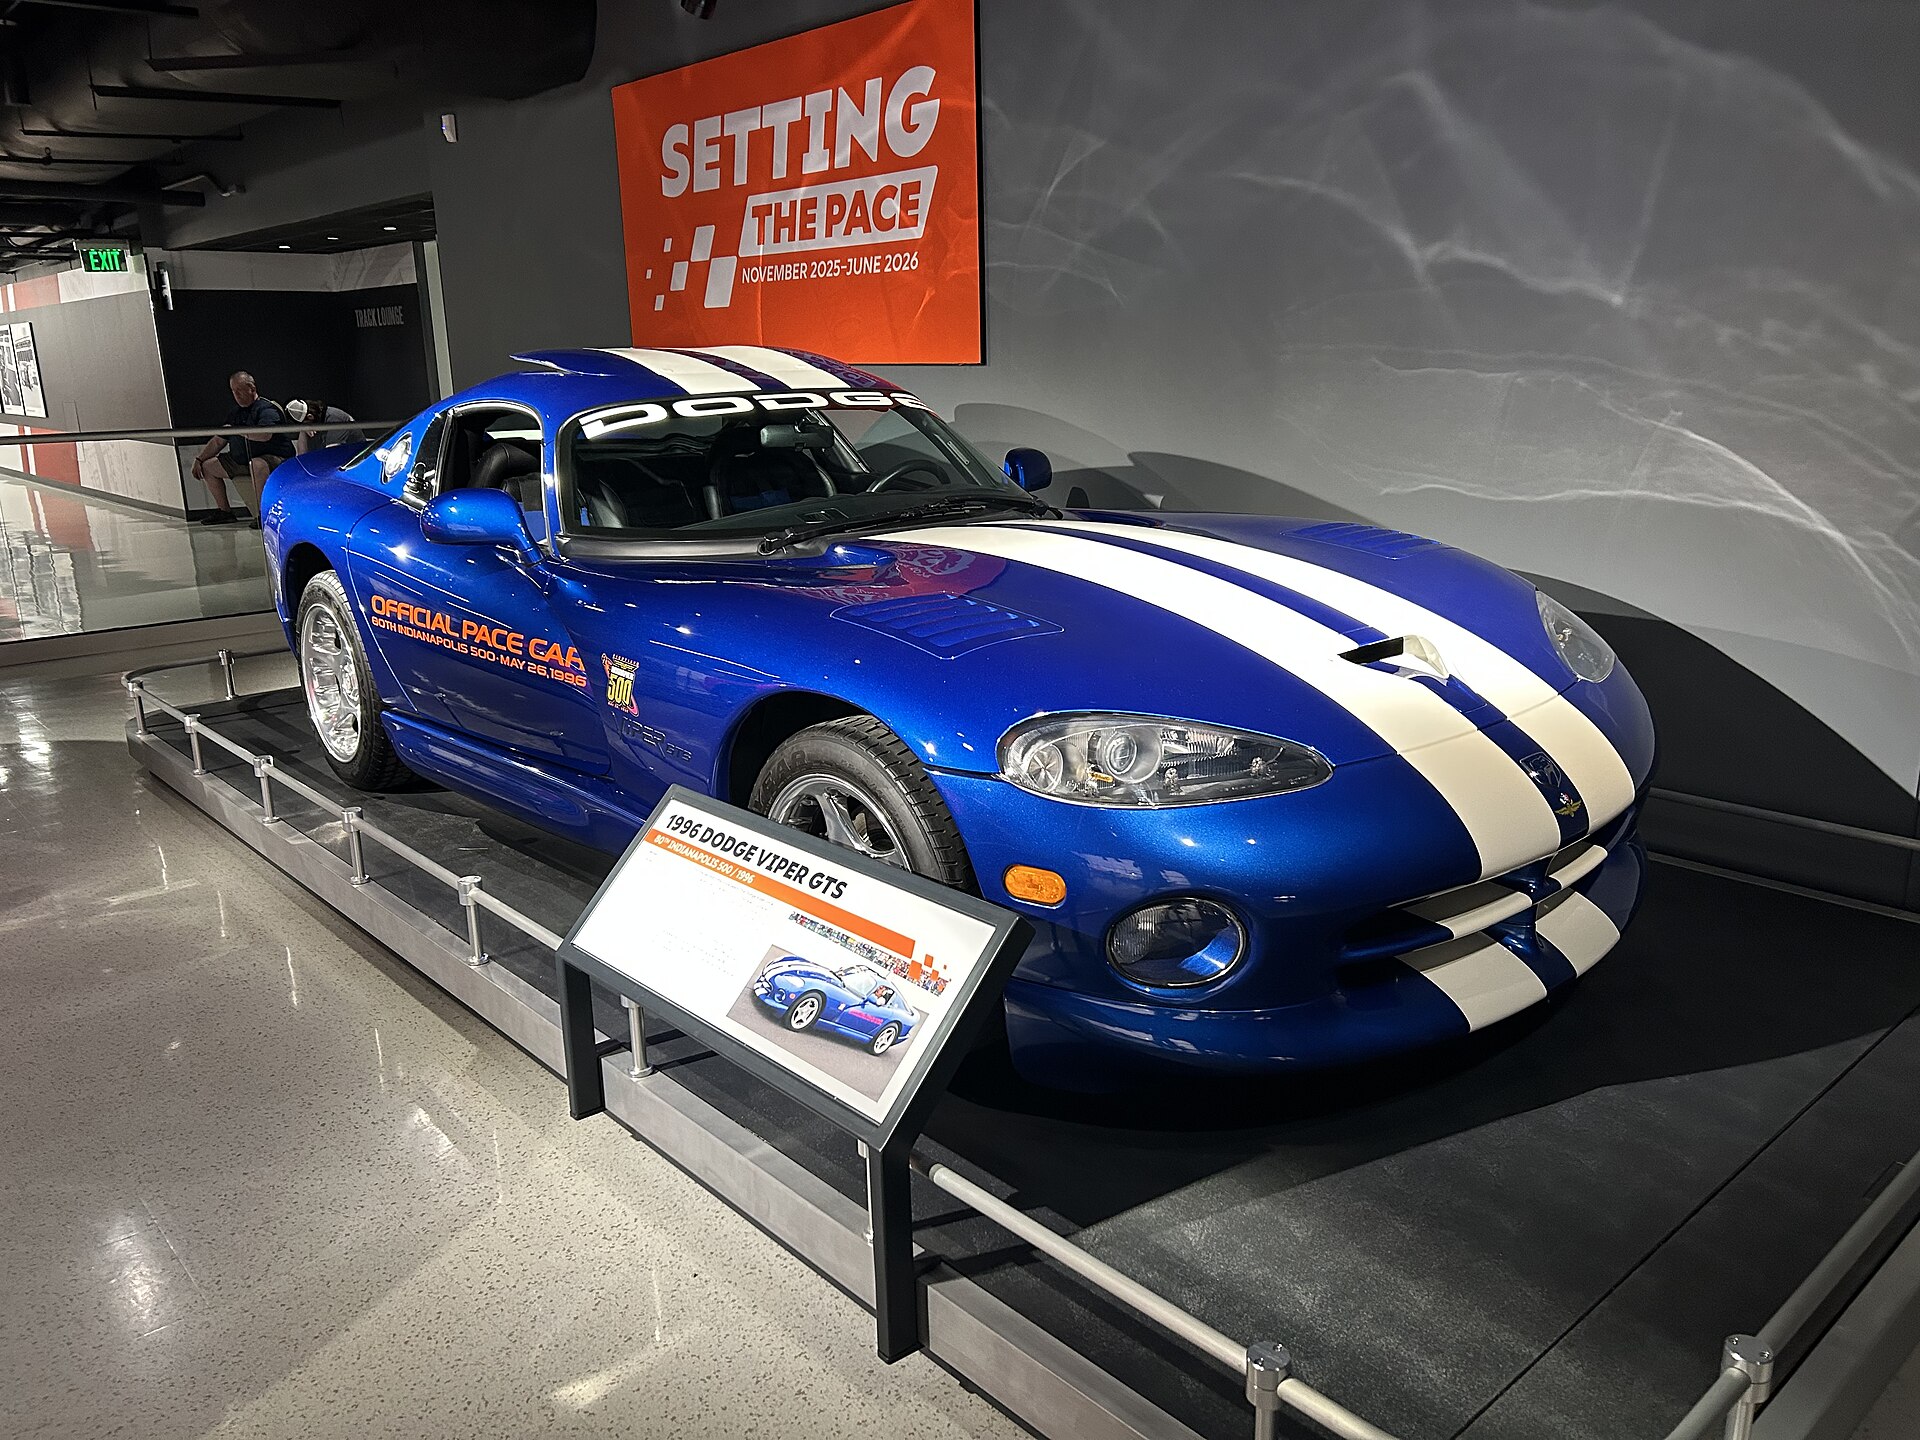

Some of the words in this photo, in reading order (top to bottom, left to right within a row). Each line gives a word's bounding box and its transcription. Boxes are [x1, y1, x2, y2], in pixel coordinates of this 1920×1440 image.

[661, 65, 941, 198] SETTING
[751, 199, 818, 246] THE
[825, 181, 922, 238] PACE
[88, 250, 121, 271] EXIT
[741, 264, 808, 284] NOVEMBER
[884, 251, 919, 273] 2026
[354, 307, 378, 328] TRACK
[376, 305, 405, 326] LOUNGE
[578, 391, 938, 439] DODGE
[371, 594, 460, 638] OFFICIAL
[462, 619, 525, 656] PACE
[371, 615, 397, 633] 80TH
[397, 624, 469, 655] INDIANAPOLIS
[607, 672, 633, 705] 500
[666, 814, 703, 839] 1996
[698, 826, 759, 863] DODGE
[756, 848, 811, 885] VIPER
[808, 871, 848, 900] GTS
[667, 839, 720, 869] INDIANAPOLIS
[716, 860, 734, 874] 500
[735, 868, 756, 884] 1996
